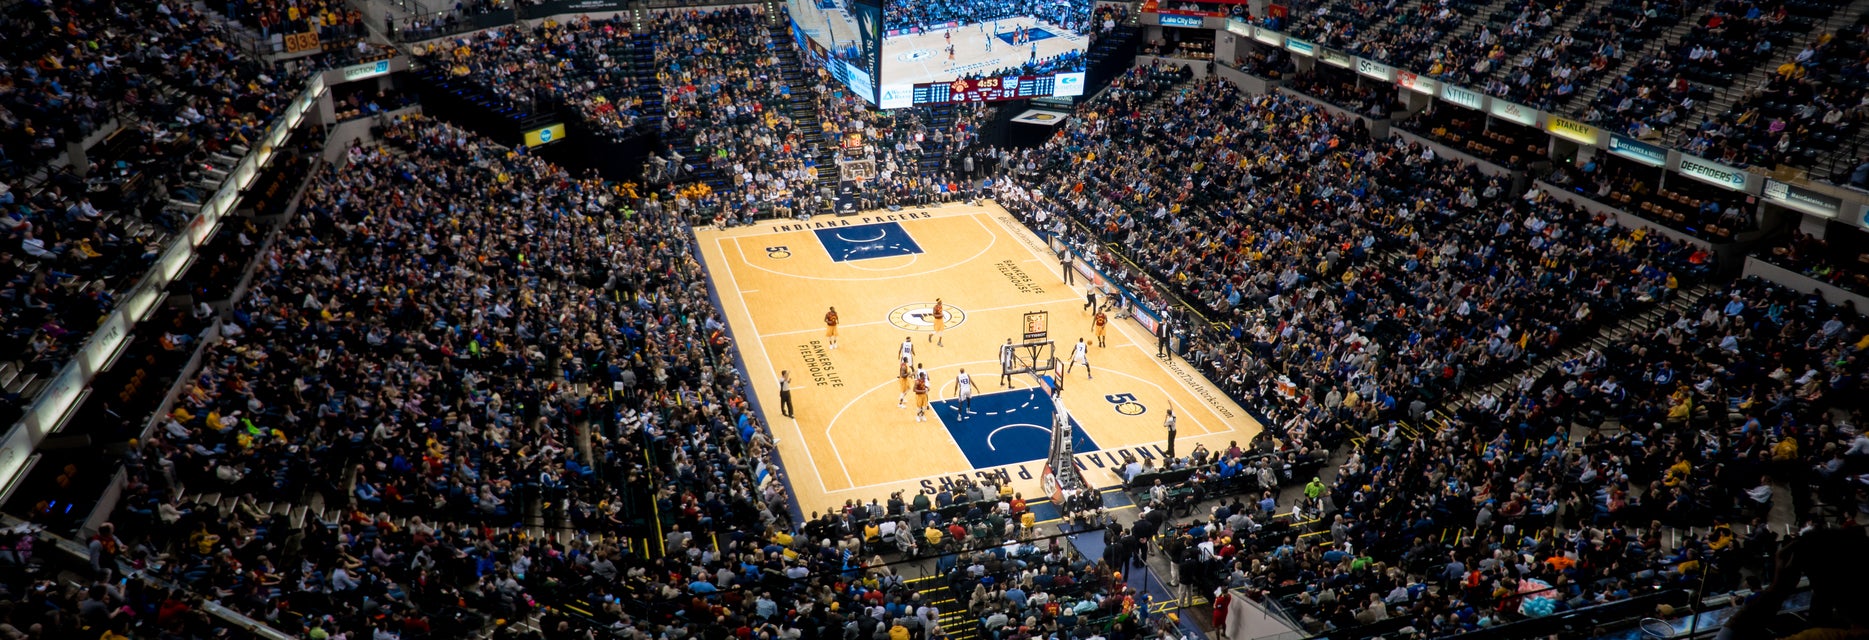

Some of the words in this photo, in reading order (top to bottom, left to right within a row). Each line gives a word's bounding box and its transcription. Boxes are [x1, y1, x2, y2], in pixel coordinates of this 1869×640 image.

[1177, 17, 1188, 26] City
[287, 33, 319, 51] 333
[345, 64, 376, 76] SECTION
[1360, 60, 1372, 72] SG
[977, 79, 998, 87] 4:53
[952, 93, 965, 101] 43
[1003, 89, 1015, 97] 51
[1556, 119, 1589, 134] STANLEY
[1681, 160, 1732, 182] DEFENDERS
[772, 219, 850, 232] INDIANA
[862, 211, 932, 224] PACERS
[994, 263, 1031, 293] FIELDHOUSE
[1003, 259, 1032, 282] BANKERS
[1027, 283, 1045, 294] LIFE
[797, 344, 828, 386] FIELDHOUSE
[810, 340, 835, 371] BANKERS
[827, 372, 844, 388] LIFE
